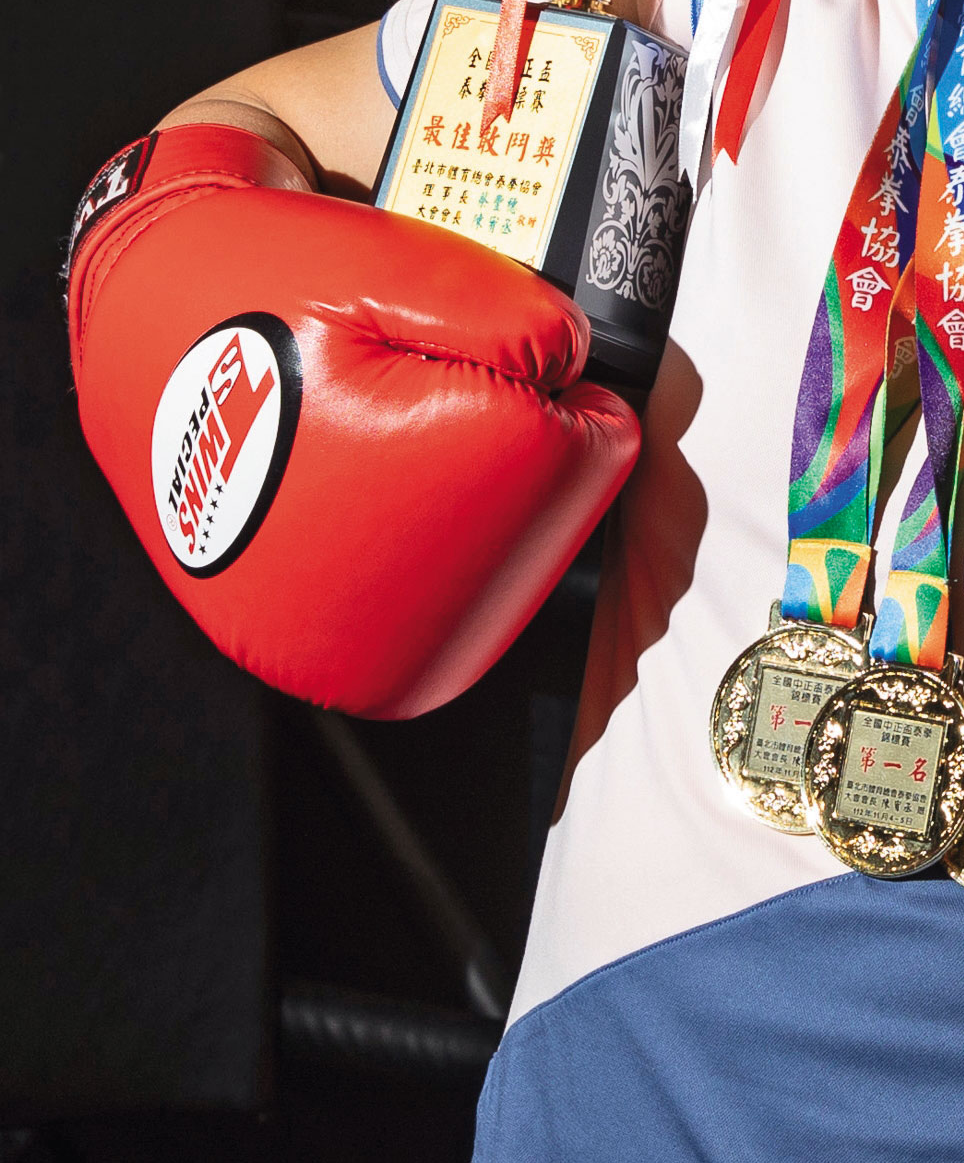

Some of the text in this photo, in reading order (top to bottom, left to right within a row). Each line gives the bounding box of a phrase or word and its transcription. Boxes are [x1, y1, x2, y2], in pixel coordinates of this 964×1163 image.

[468, 47, 553, 82] 全正盃
[422, 183, 469, 205] 理事長
[770, 704, 812, 731] 第一
[862, 716, 933, 738] 全國中正盃泰拳
[881, 731, 911, 747] 錦標賽
[860, 746, 928, 782] 第一名
